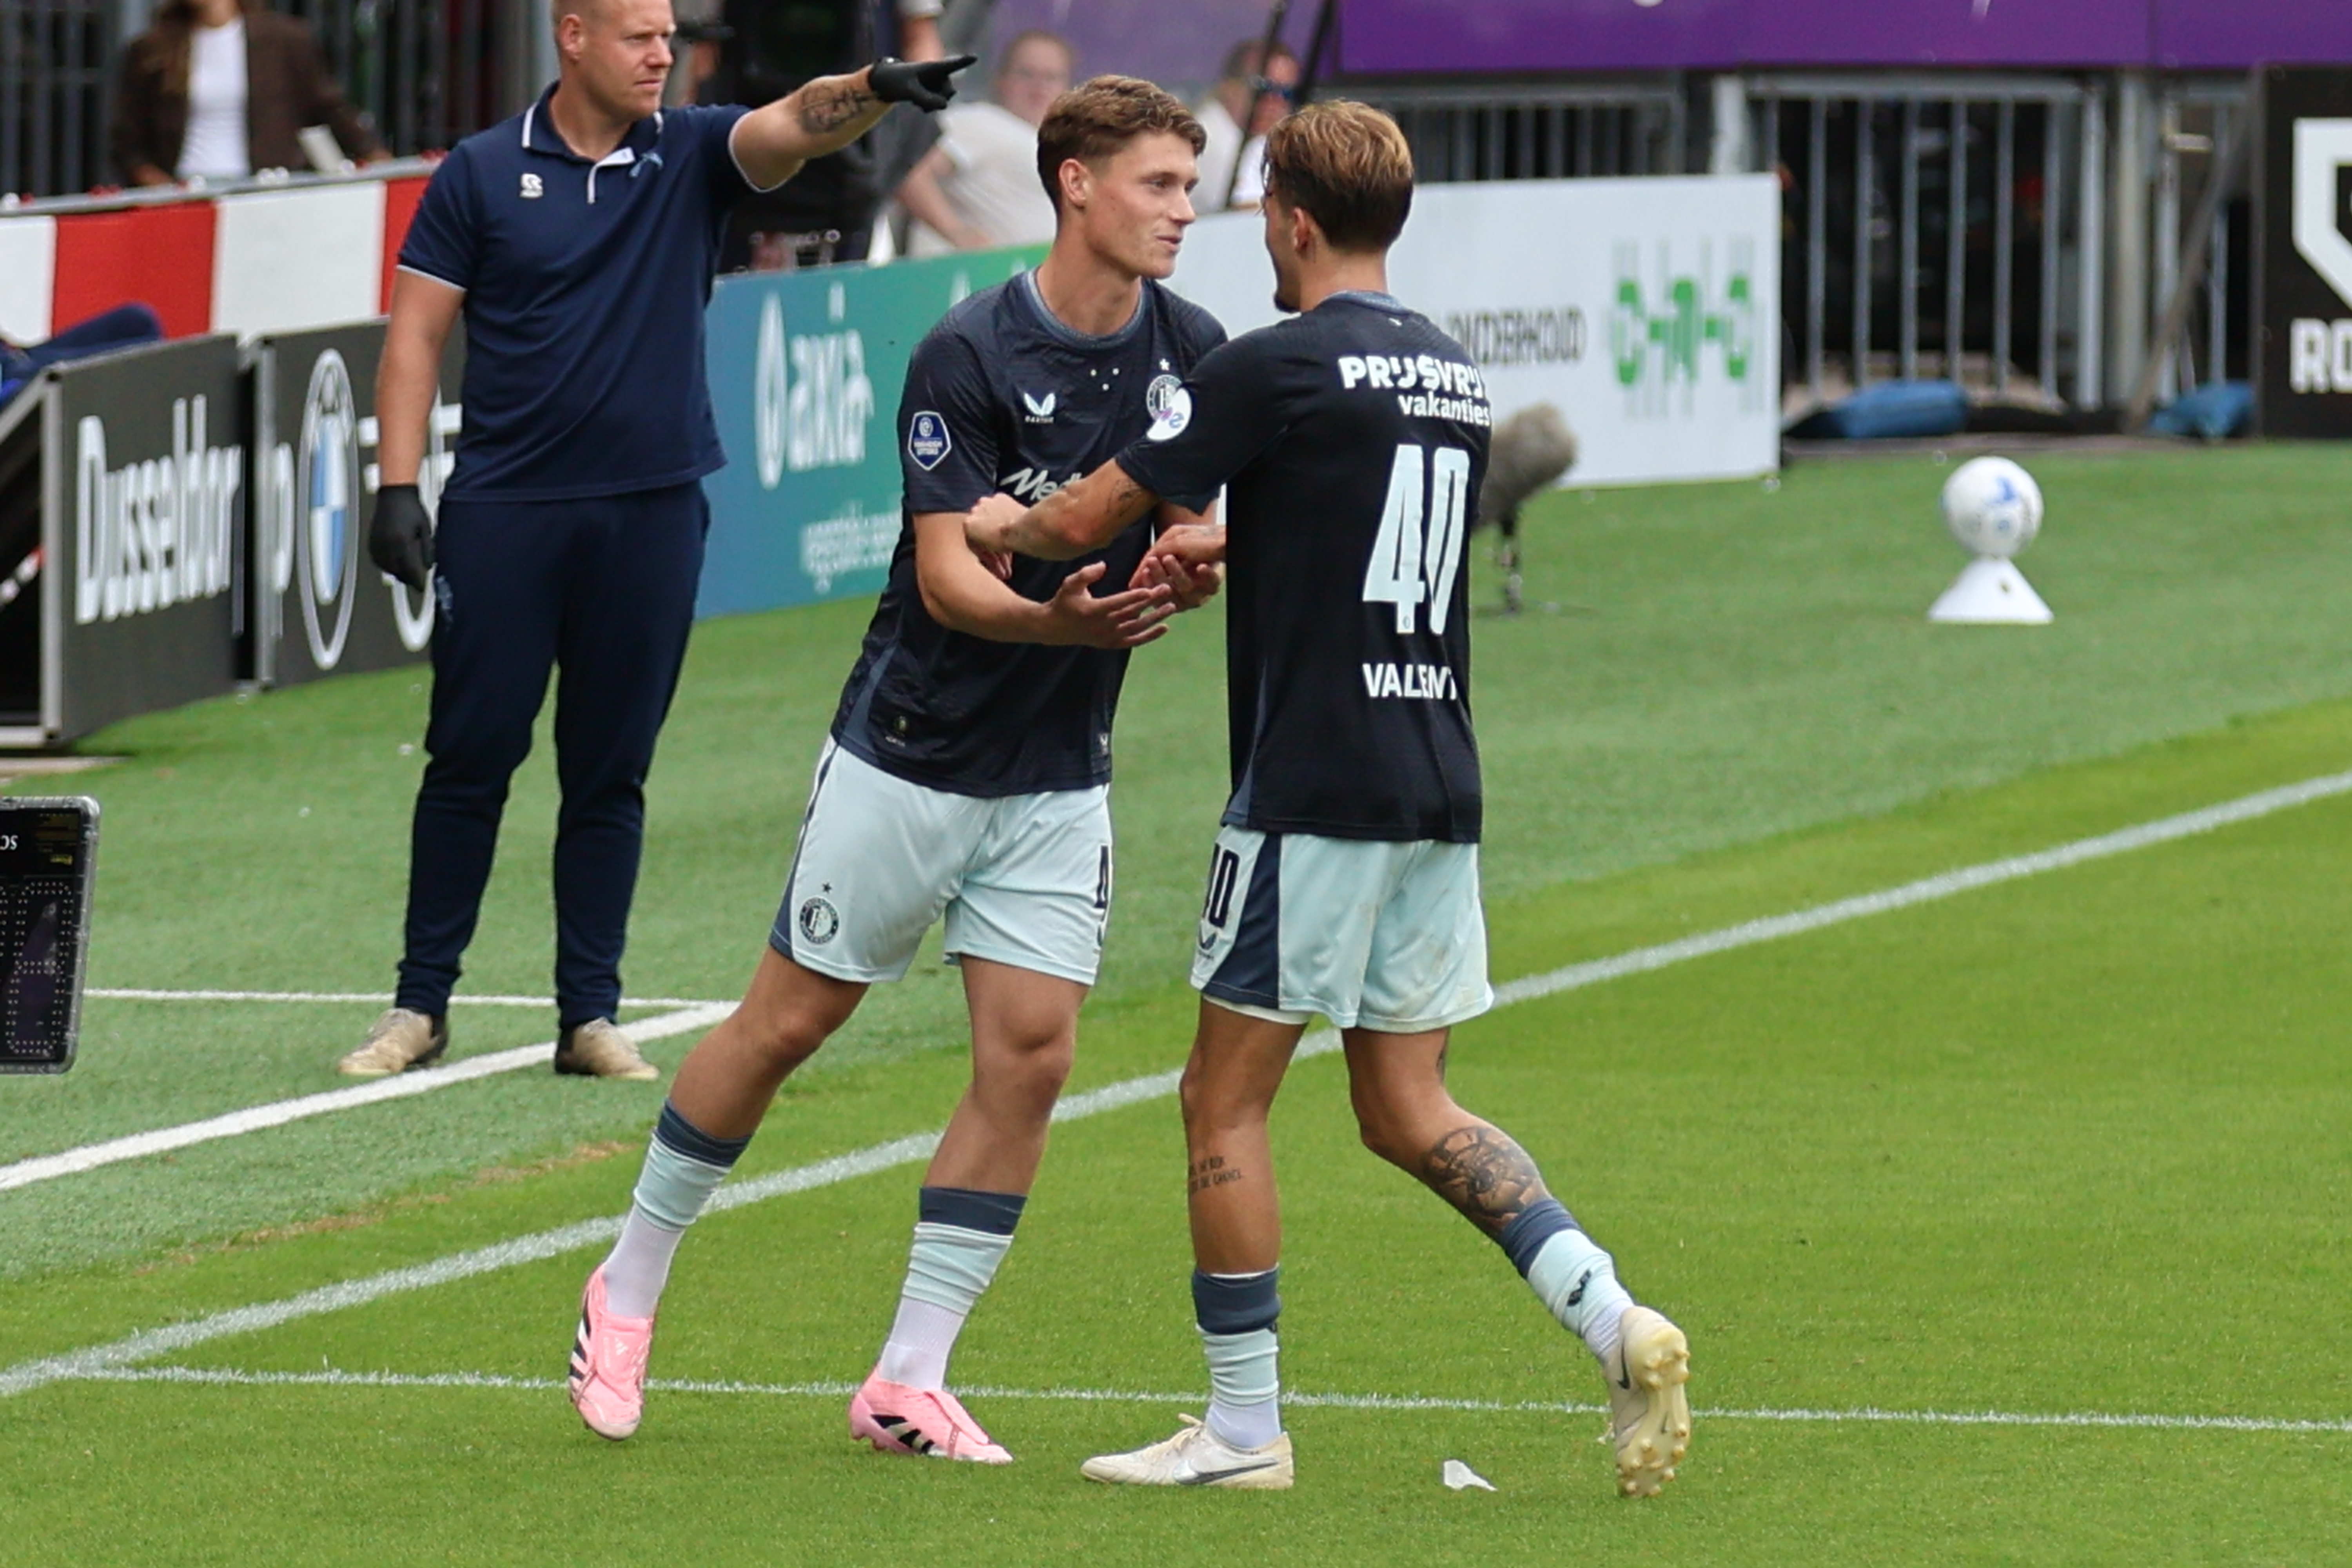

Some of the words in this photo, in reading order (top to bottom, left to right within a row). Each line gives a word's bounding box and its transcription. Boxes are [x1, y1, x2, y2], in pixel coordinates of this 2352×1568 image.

[1446, 307, 1588, 360] NDERHOUD
[1338, 354, 1484, 398] PRIJSVRIJ
[1398, 390, 1490, 426] vakanties
[1362, 444, 1470, 635] 40
[1201, 842, 1240, 929] 0
